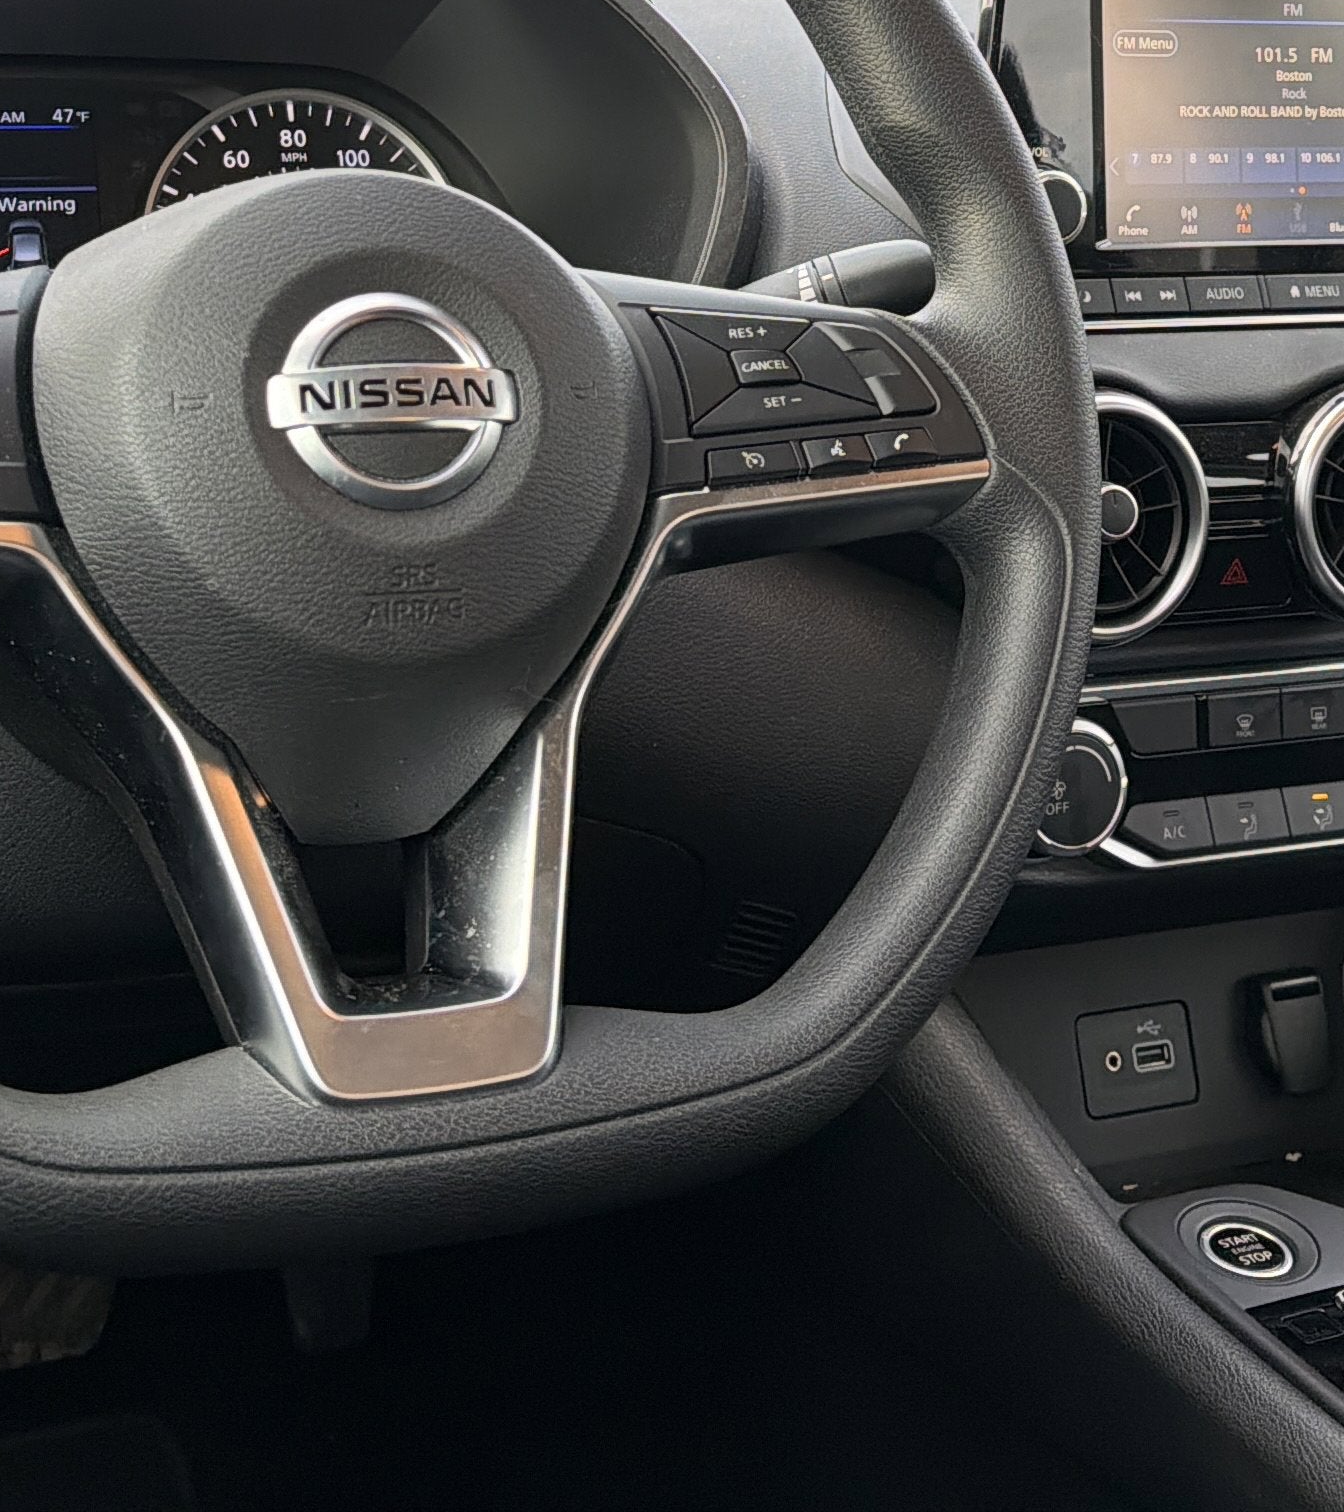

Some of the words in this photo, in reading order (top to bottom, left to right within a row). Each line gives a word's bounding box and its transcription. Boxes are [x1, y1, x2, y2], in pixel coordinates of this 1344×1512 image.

[1283, 3, 1303, 17] FM
[1117, 37, 1135, 50] FM
[1139, 37, 1174, 50] Menu
[1256, 47, 1298, 63] 101.5
[1311, 47, 1334, 63] FM
[1275, 70, 1313, 82] Boston
[1282, 87, 1307, 99] Rock
[0, 111, 25, 123] AM
[1179, 105, 1210, 118] ROCK
[1213, 105, 1238, 118] AND
[1240, 105, 1269, 118] ROLL
[1270, 105, 1302, 118] BAND
[1305, 105, 1318, 121] by
[223, 150, 250, 169] 60
[279, 129, 307, 147] 80
[336, 149, 370, 168] 100
[281, 152, 308, 163] MPH
[1151, 153, 1172, 164] 87.9
[1189, 153, 1197, 164] 8
[1208, 153, 1229, 164] 90.1
[1246, 152, 1254, 164] 9
[1264, 153, 1285, 164] 98.1
[1118, 225, 1149, 236] Phone
[1181, 225, 1198, 235] AM
[1236, 224, 1252, 233] FM
[1206, 286, 1244, 300] AUDIO
[1306, 285, 1340, 298] MENU
[729, 327, 754, 339] RES
[741, 359, 790, 373] CANCEL
[299, 376, 497, 412] NISSAN
[763, 395, 786, 408] SET
[1046, 802, 1070, 816] OFF
[1163, 825, 1187, 839] A/C
[1218, 1233, 1258, 1248] START
[1238, 1250, 1272, 1266] STOP
